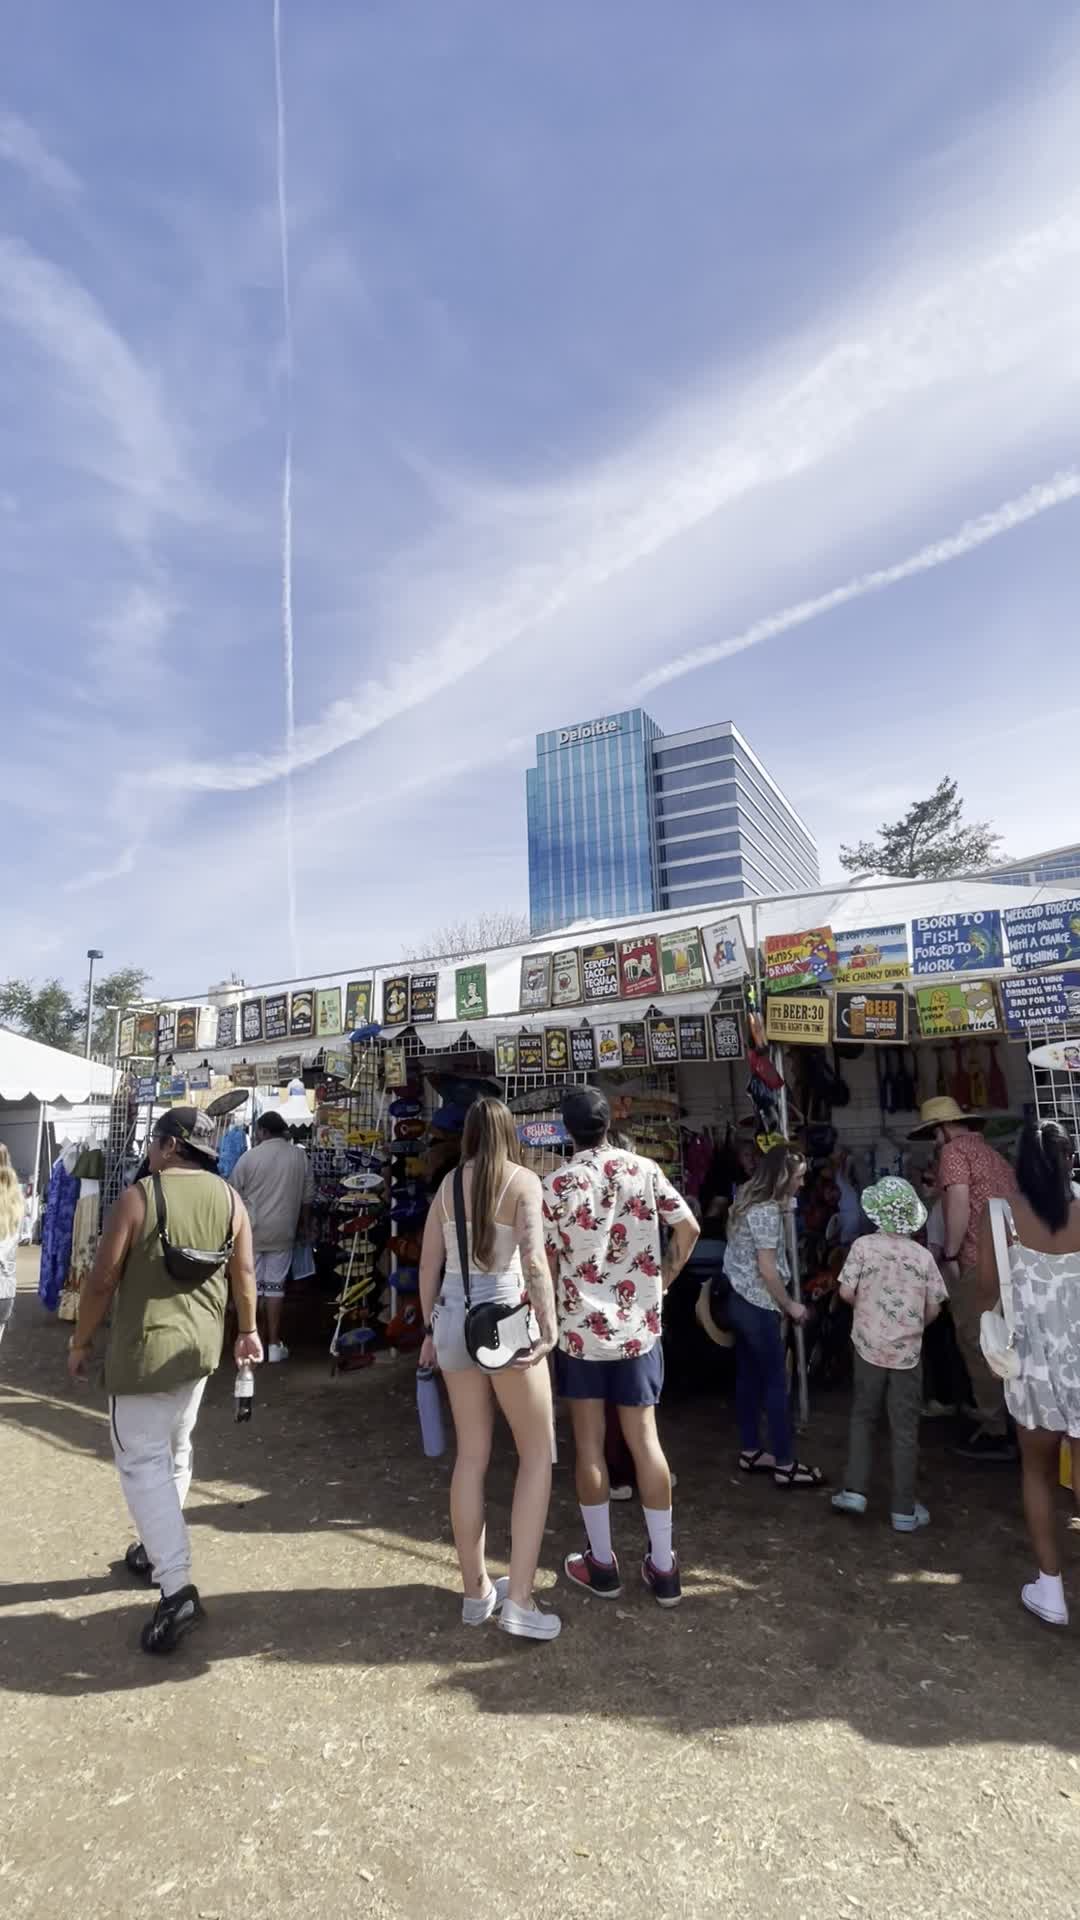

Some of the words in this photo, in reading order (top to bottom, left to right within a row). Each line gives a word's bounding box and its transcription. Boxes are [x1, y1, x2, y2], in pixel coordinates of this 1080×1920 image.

[559, 720, 617, 746] Deloitte
[1044, 900, 1080, 916] FORECAS
[917, 915, 957, 931] BORN
[960, 912, 985, 926] TO
[922, 929, 959, 945] FISH
[1009, 938, 1029, 951] WITH
[1030, 936, 1039, 949] A
[1040, 932, 1072, 946] CHANCE
[622, 938, 654, 955] BEER
[914, 943, 955, 960] FORCED
[955, 941, 972, 955] TO
[1011, 953, 1024, 966] OF
[1025, 948, 1060, 965] FISHING
[585, 968, 606, 979] TACO
[917, 958, 956, 974] WORK
[585, 974, 617, 989] TEQUILA
[1005, 980, 1026, 988] USED
[1040, 974, 1065, 985] THINK
[1043, 984, 1063, 993] WAS
[591, 983, 618, 996] REPEAT
[865, 1000, 897, 1017] BEER
[1010, 997, 1027, 1007] BAD
[1028, 995, 1046, 1006] FOR
[770, 1007, 782, 1018] IT'S
[783, 1003, 824, 1020] BEER:30
[1008, 1010, 1021, 1019] SO
[1022, 1009, 1026, 1018] I
[1028, 1006, 1053, 1017] GAVE
[1054, 1005, 1067, 1014] UP
[572, 1039, 593, 1050] MAN
[718, 1034, 737, 1045] BEER
[573, 1050, 594, 1061] CAVE
